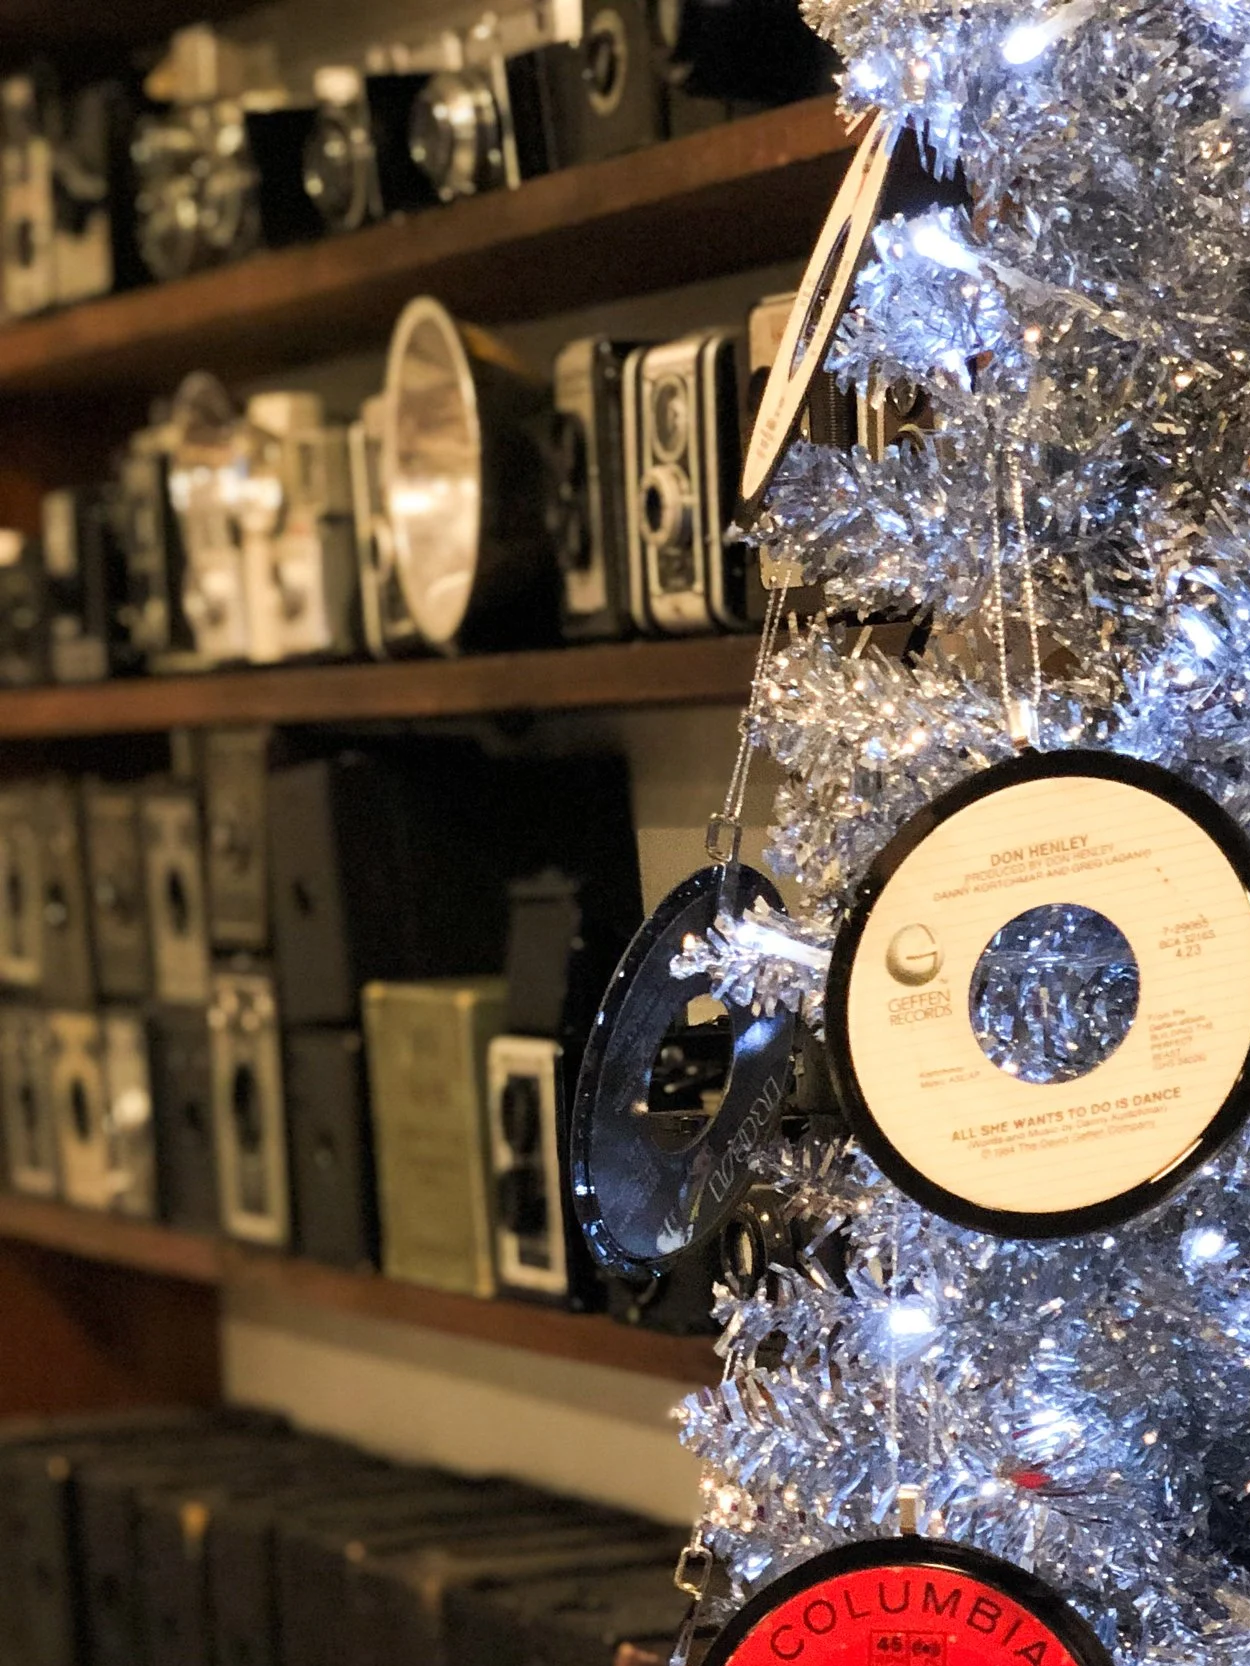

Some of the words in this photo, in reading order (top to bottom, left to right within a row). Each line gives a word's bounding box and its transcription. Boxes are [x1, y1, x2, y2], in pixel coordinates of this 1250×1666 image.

[990, 848, 1024, 867] DON
[1029, 835, 1088, 857] HENLEY
[888, 990, 951, 1013] GEFFEN
[890, 1004, 953, 1026] RECORDS
[952, 1127, 977, 1142] ALL
[981, 1122, 1008, 1138] SHE
[1013, 1110, 1064, 1130] WANTS
[1068, 1106, 1087, 1119] TO
[1091, 1101, 1111, 1115] DO
[1116, 1096, 1128, 1109] IS
[1132, 1086, 1182, 1106] DANCE
[876, 1636, 903, 1651] 45
